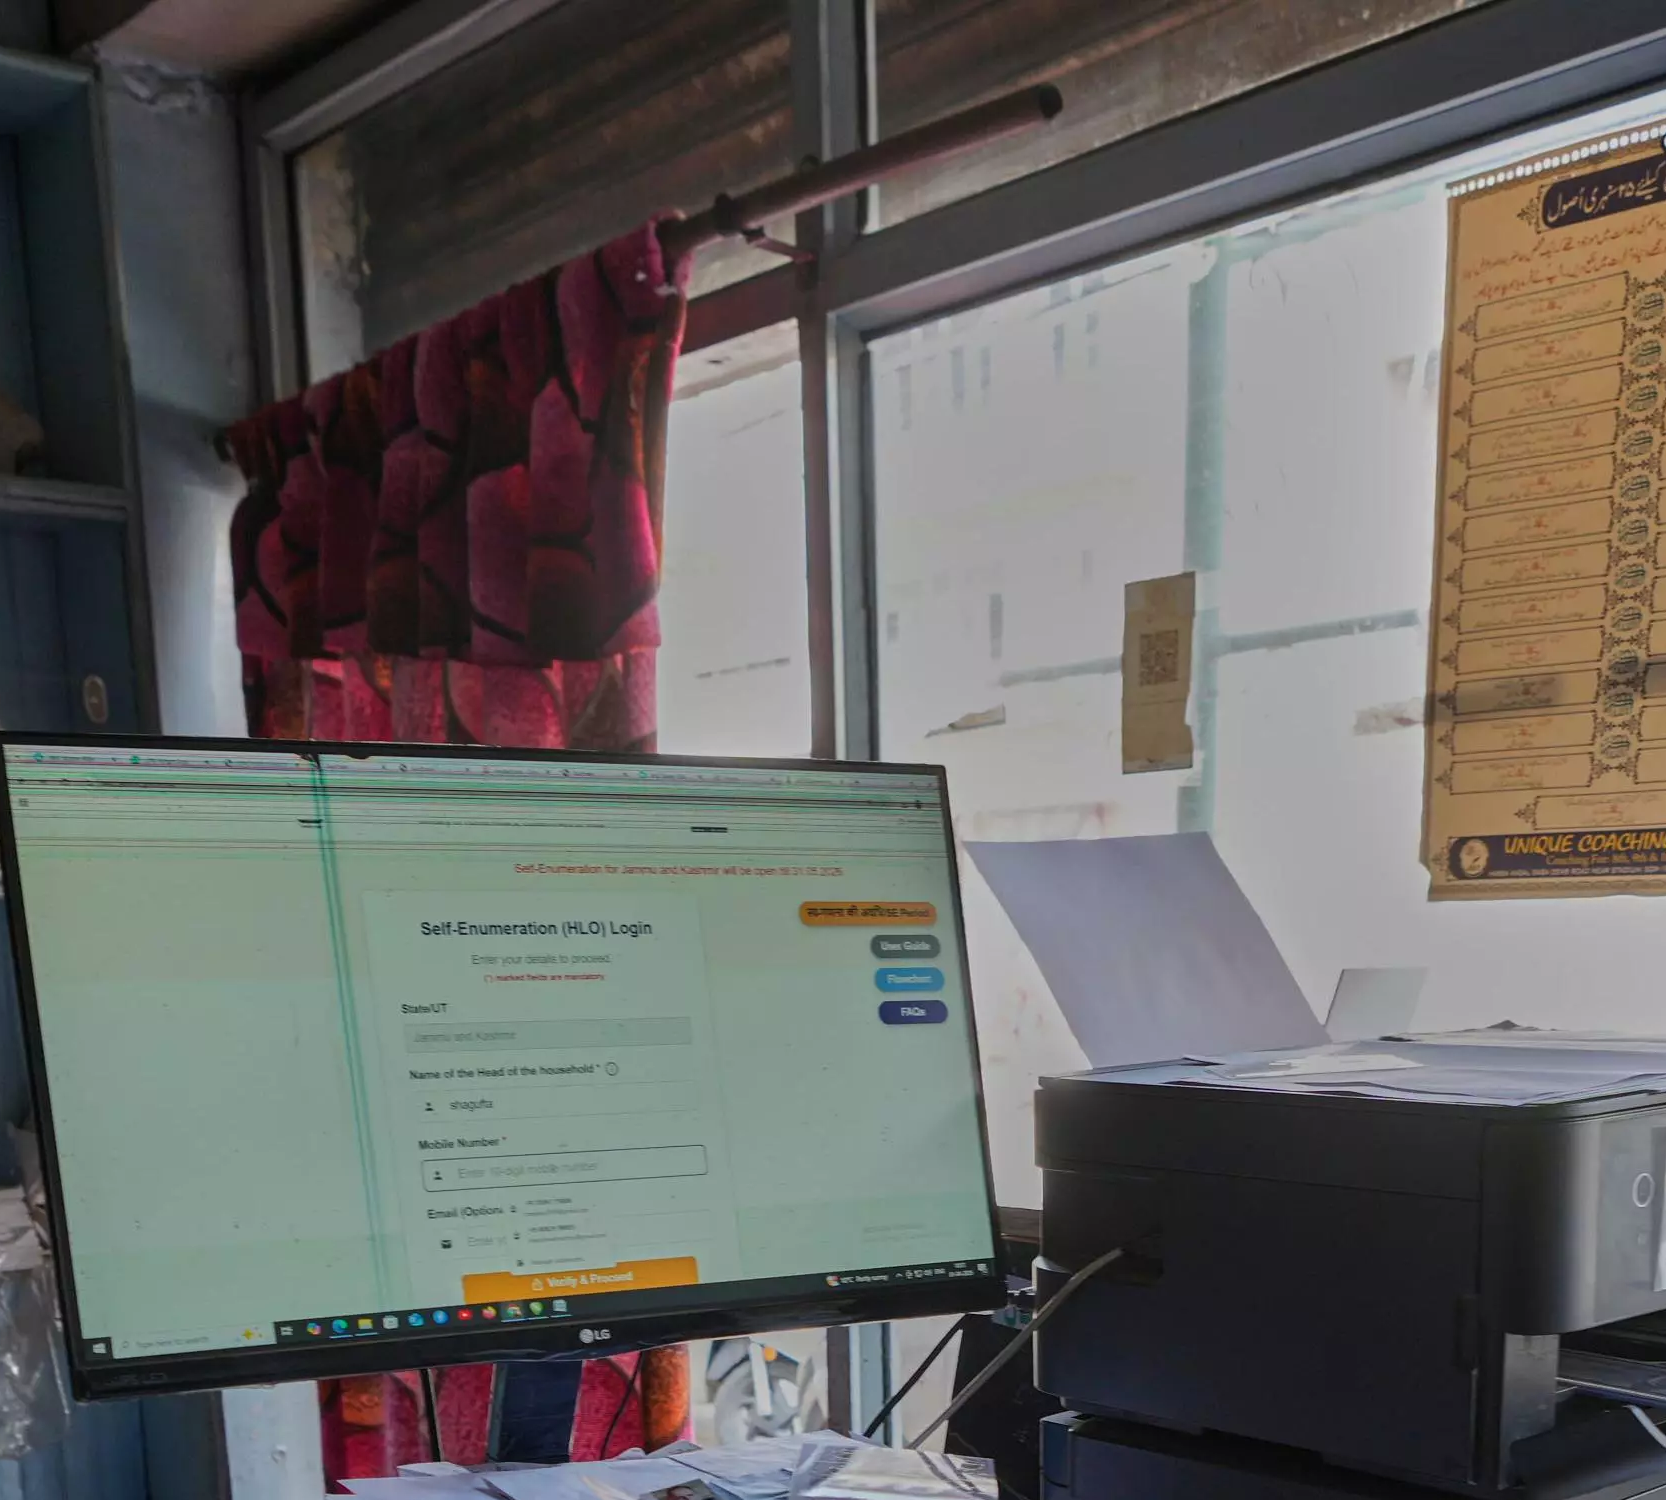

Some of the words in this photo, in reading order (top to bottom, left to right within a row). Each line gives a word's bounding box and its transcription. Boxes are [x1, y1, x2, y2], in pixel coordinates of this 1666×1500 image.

[1504, 834, 1575, 855] UNIQUE
[420, 921, 558, 937] Self-Enumeration
[562, 921, 607, 938] (HLO)
[610, 921, 653, 938] Login
[471, 954, 498, 966] Enter
[501, 955, 523, 967] your
[401, 1003, 449, 1015] State/UT
[409, 1070, 441, 1080] Name
[444, 1068, 455, 1079] of
[457, 1068, 475, 1078] the
[477, 1066, 506, 1078] Head
[507, 1066, 519, 1077] of
[520, 1065, 537, 1077] the
[539, 1064, 595, 1076] household
[418, 1138, 455, 1150] Mobile
[457, 1137, 500, 1149] Number
[427, 1207, 458, 1219] Email
[461, 1206, 504, 1220] (Option
